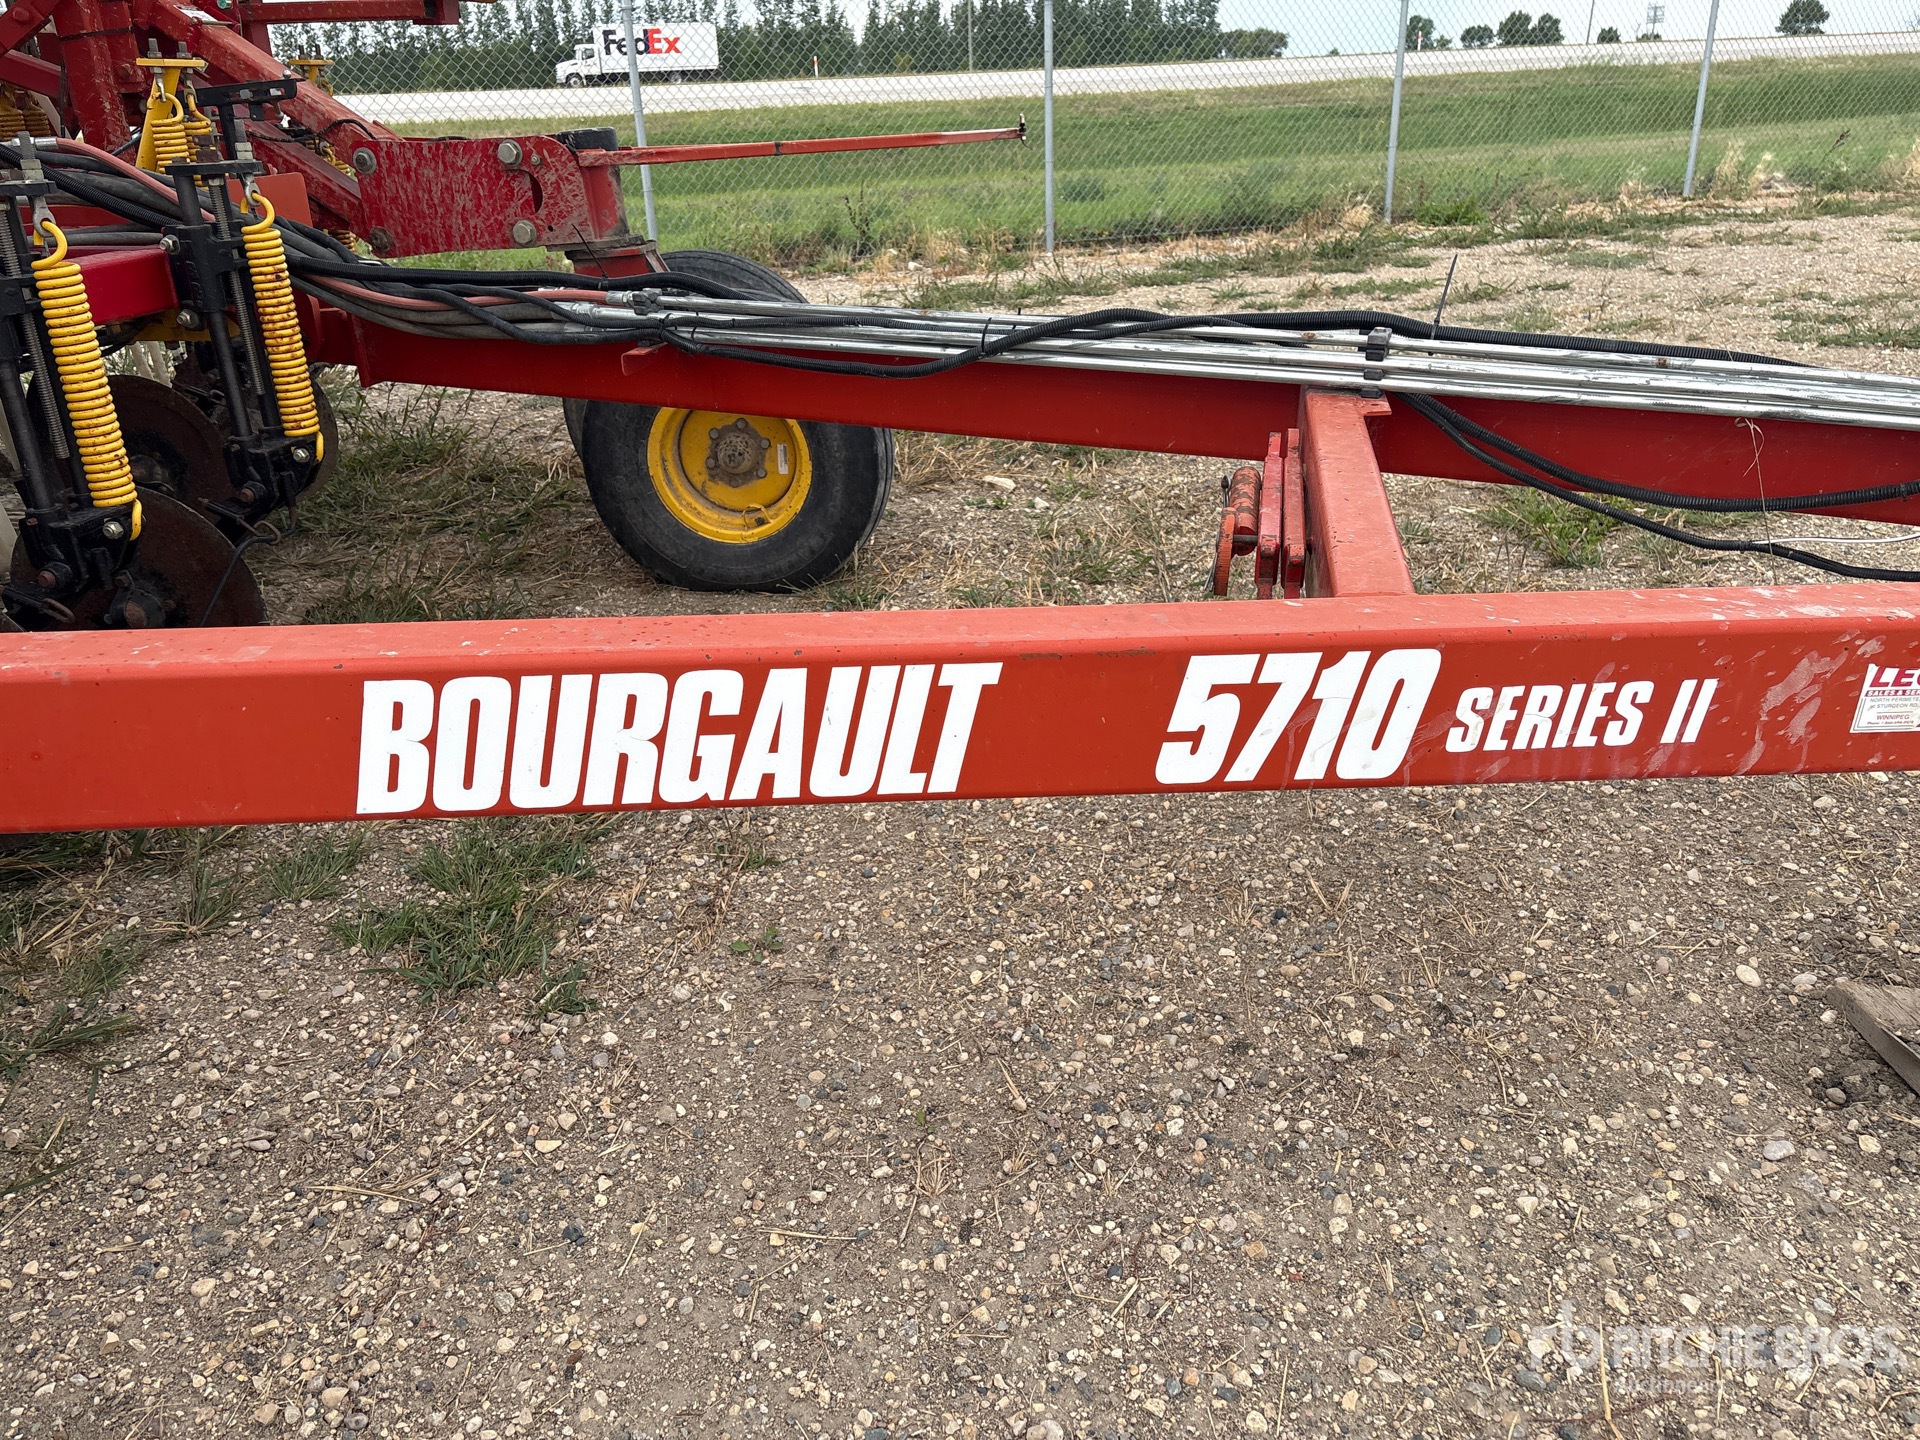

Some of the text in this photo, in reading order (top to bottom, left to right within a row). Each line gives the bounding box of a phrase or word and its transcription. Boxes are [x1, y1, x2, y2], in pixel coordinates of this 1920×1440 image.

[602, 28, 682, 55] FedEx
[1869, 667, 1920, 688] LE
[356, 648, 1720, 815] BOURGAULT 5710 SERIES II
